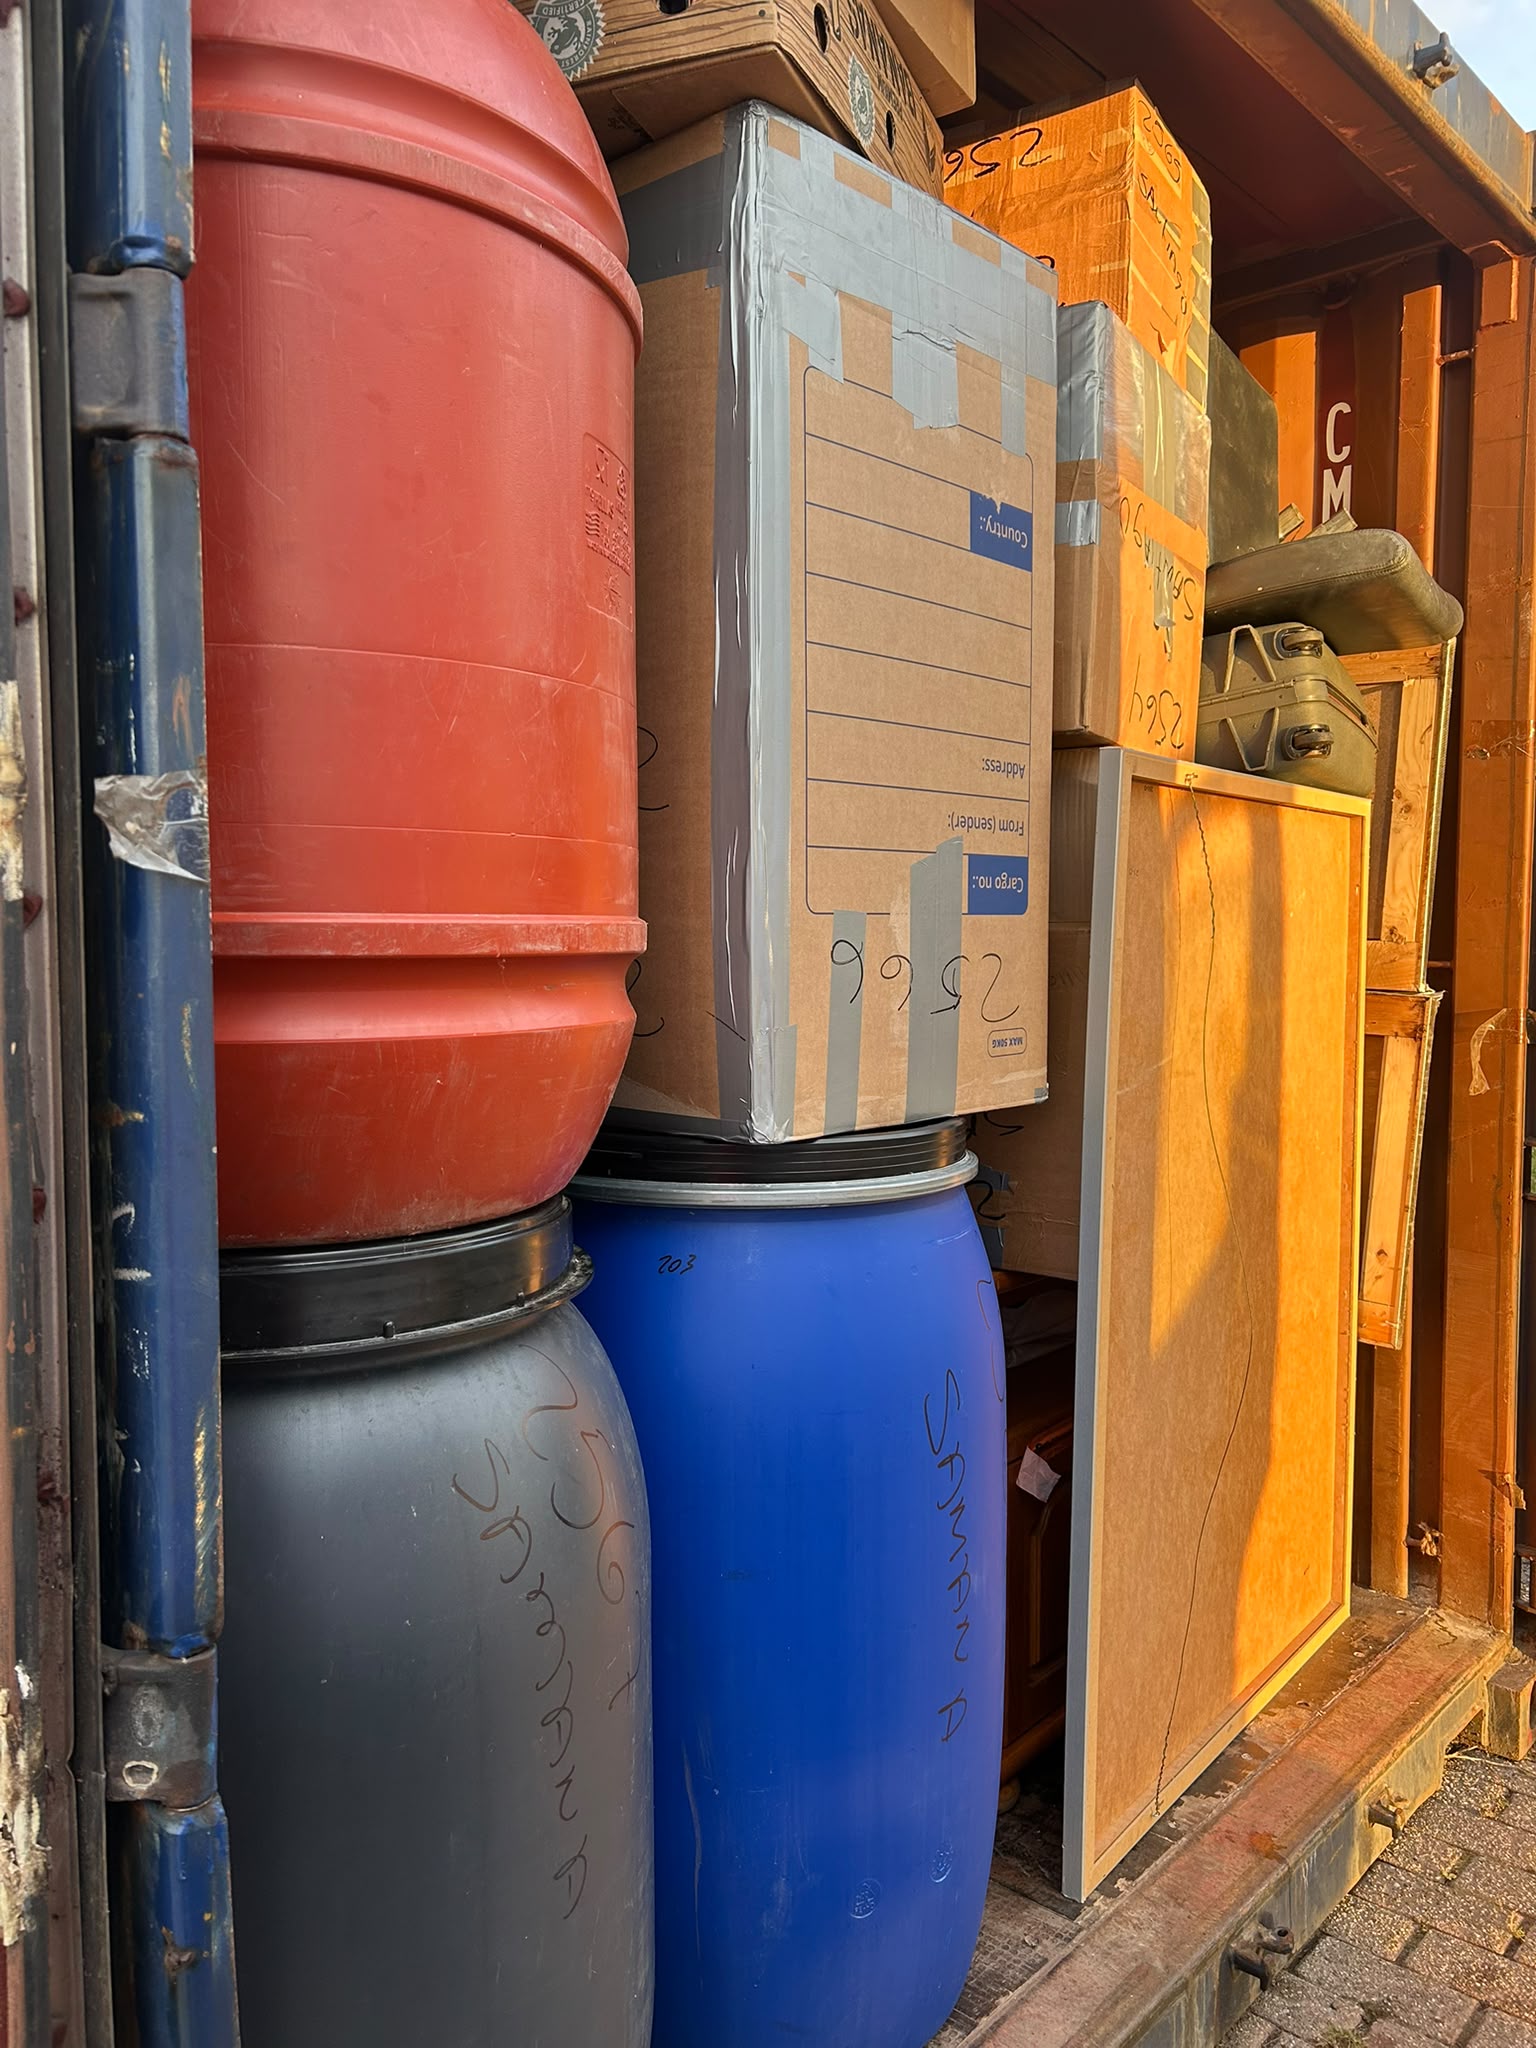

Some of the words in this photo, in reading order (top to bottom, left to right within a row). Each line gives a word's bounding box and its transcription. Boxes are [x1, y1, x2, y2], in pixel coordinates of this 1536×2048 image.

[541, 0, 586, 17] CERTIFIED
[981, 758, 1026, 779] Address:
[947, 811, 997, 834] (sender):
[998, 820, 1025, 836] From
[995, 872, 1025, 893] Cargo
[991, 1037, 1009, 1049] 50KG
[1008, 1036, 1024, 1047] MAX
